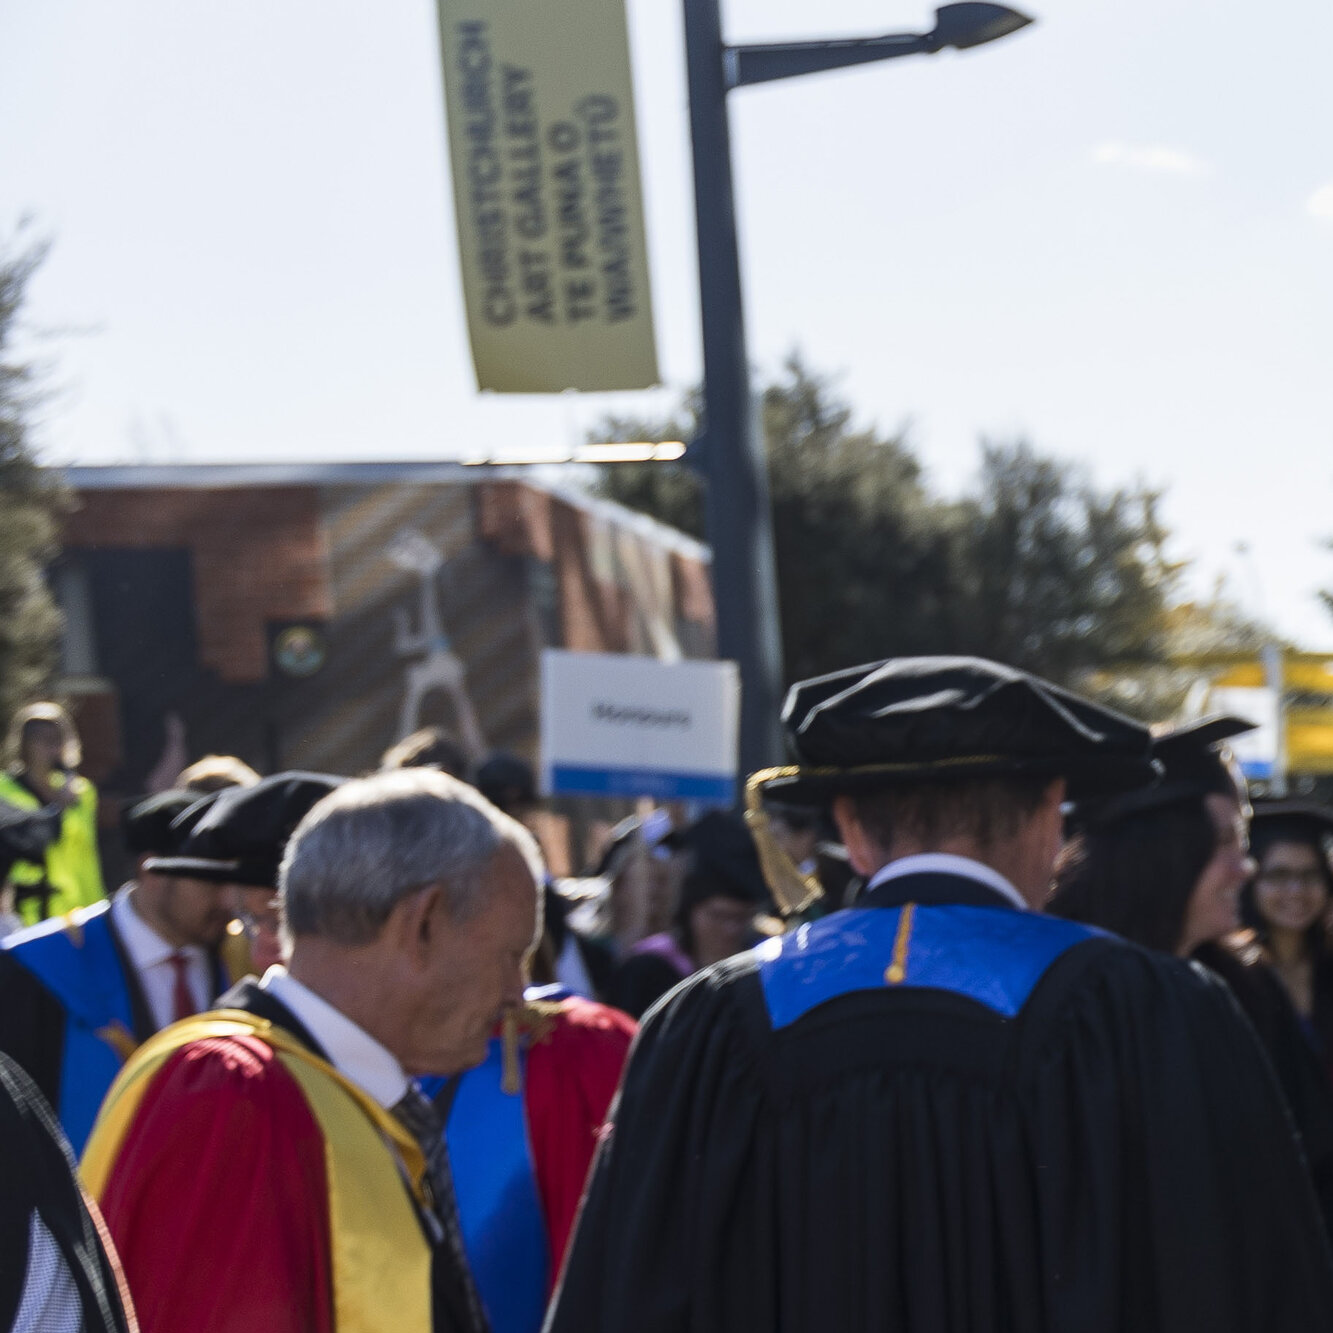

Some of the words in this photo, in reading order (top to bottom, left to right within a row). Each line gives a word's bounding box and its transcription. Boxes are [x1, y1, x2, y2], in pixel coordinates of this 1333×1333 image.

[456, 20, 517, 327] CHRISTCHURCH
[499, 64, 547, 241] GALLERY
[548, 121, 581, 151] O
[553, 160, 590, 270] PUNA
[516, 251, 554, 324] ART
[565, 277, 597, 323] TE
